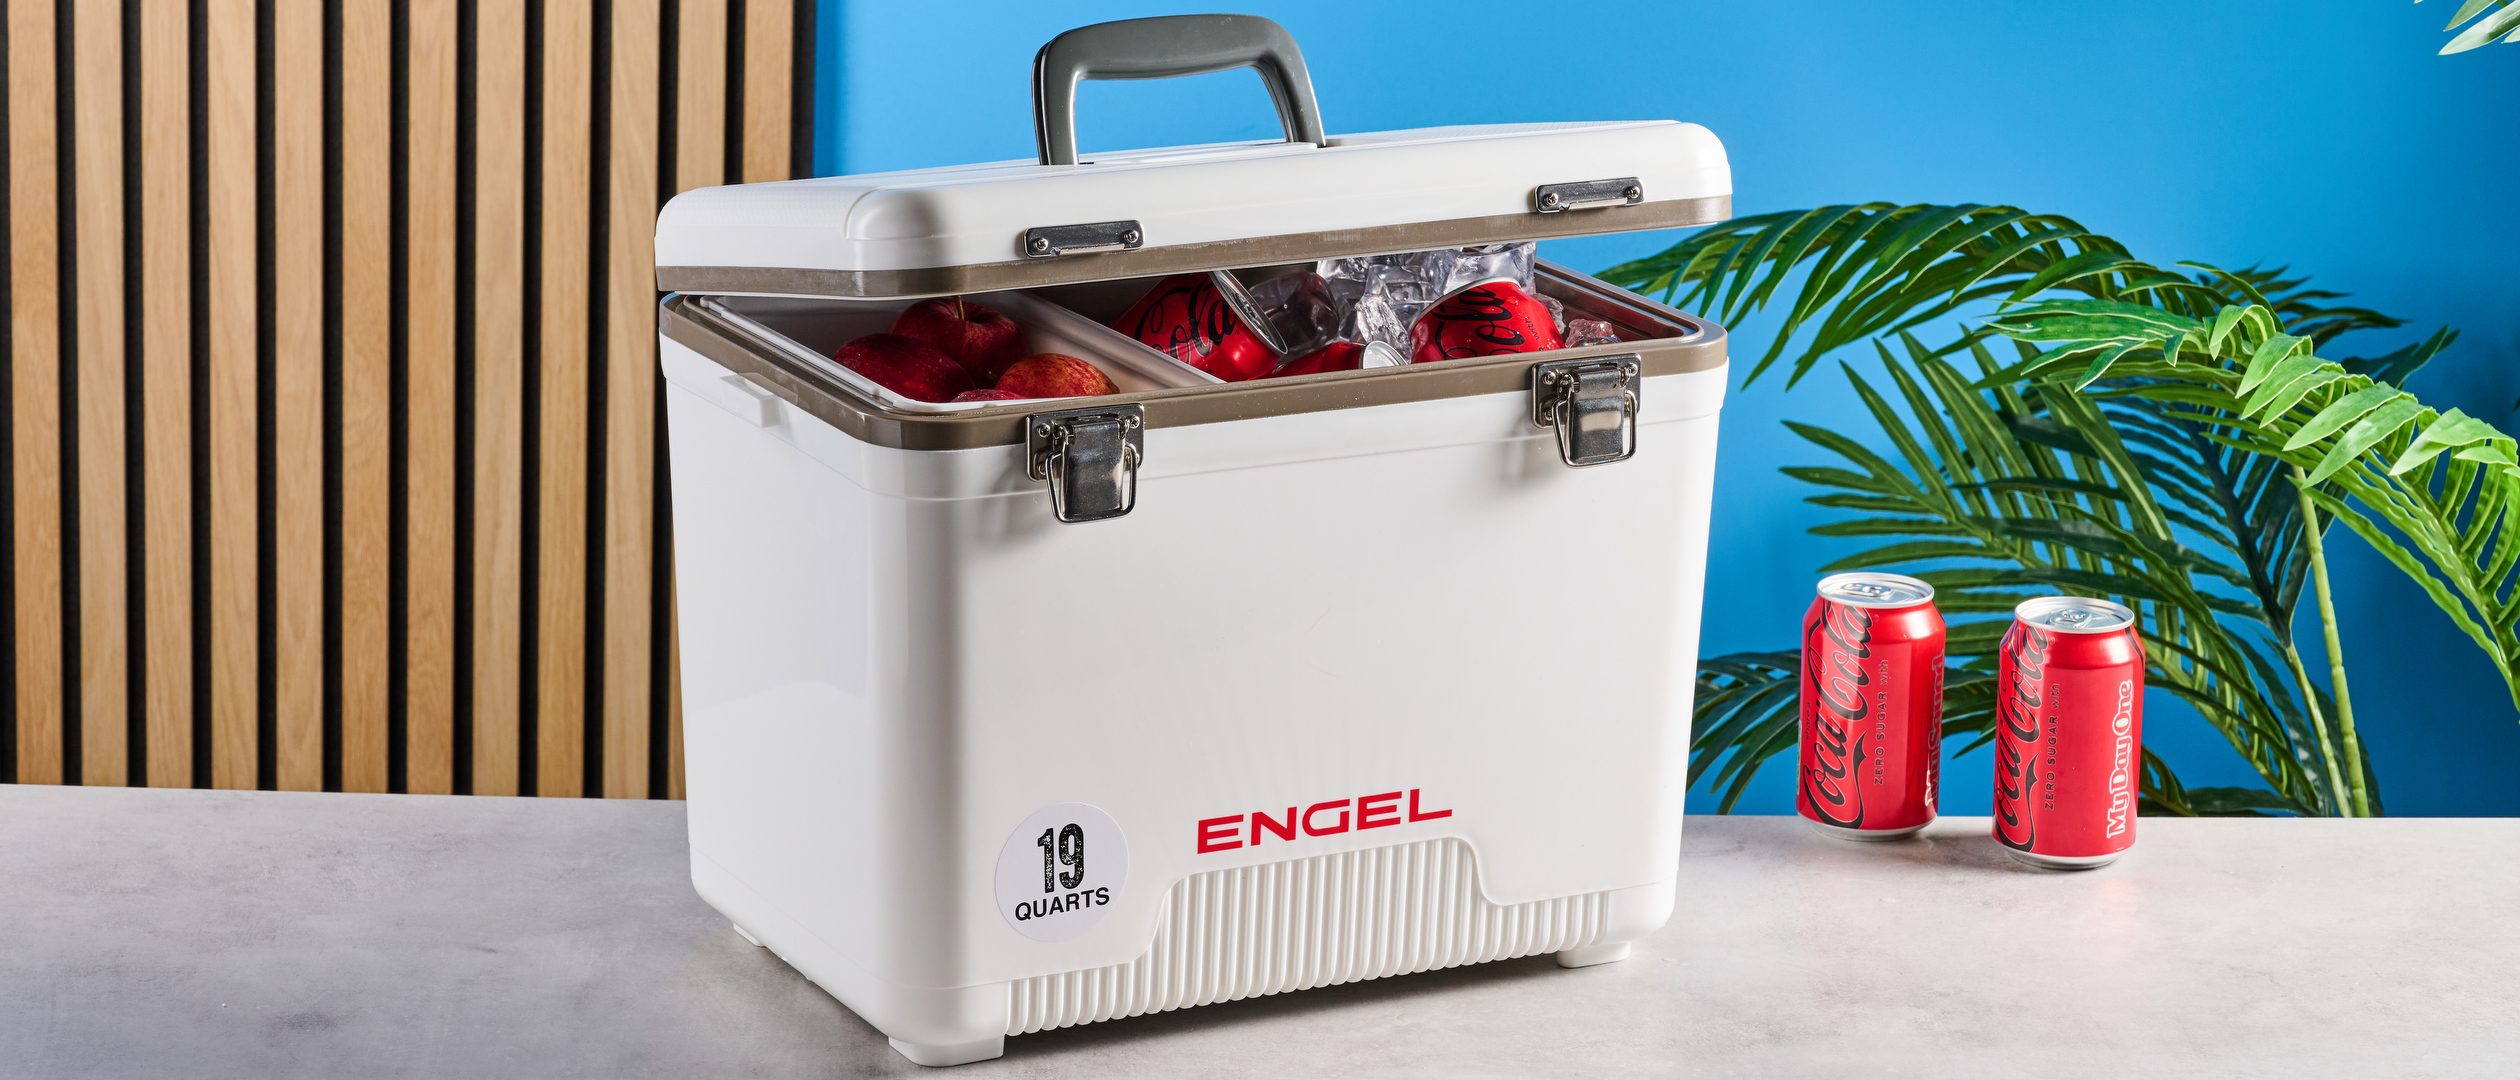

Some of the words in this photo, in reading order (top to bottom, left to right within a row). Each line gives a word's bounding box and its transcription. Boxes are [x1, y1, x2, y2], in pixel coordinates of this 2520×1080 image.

[1525, 316, 1540, 341] with
[1878, 660, 1889, 686] with
[2051, 683, 2060, 709] with
[1876, 692, 1887, 741] SUGAR
[2047, 716, 2058, 765] SUGAR
[1874, 747, 1886, 785] ZERO
[2045, 772, 2055, 811] ZERO
[1197, 788, 1454, 855] ENGEL
[1037, 823, 1086, 893] 19
[1015, 886, 1111, 921] QUARTS
